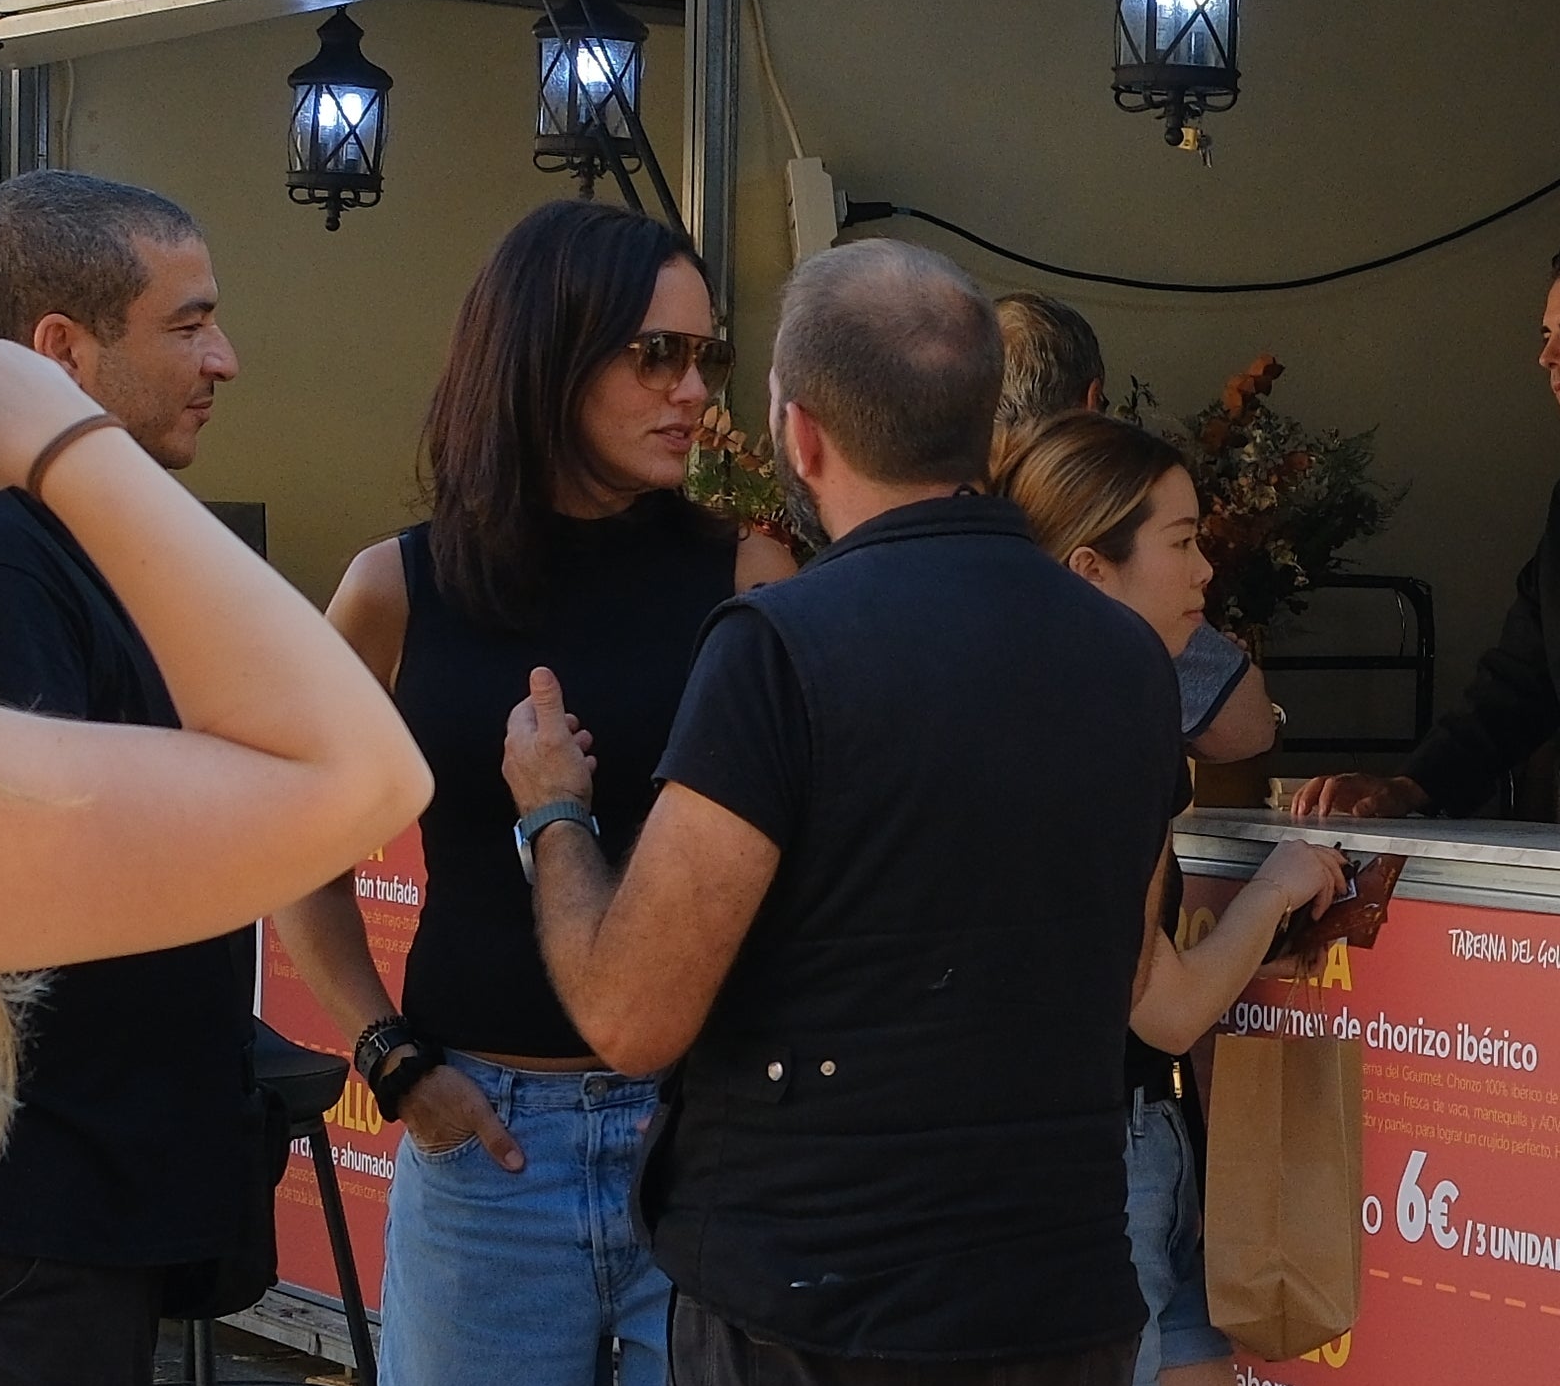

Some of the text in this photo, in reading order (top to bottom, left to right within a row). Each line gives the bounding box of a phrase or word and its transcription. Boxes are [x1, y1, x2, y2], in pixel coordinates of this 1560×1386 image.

[376, 874, 419, 906] trufada
[1448, 929, 1506, 962] TABERNA
[1511, 938, 1534, 963] DEL
[1366, 1016, 1450, 1060] chorizo
[1456, 1025, 1538, 1073] ibérico
[340, 1142, 395, 1180] ahumado
[1396, 1150, 1460, 1250] 6€
